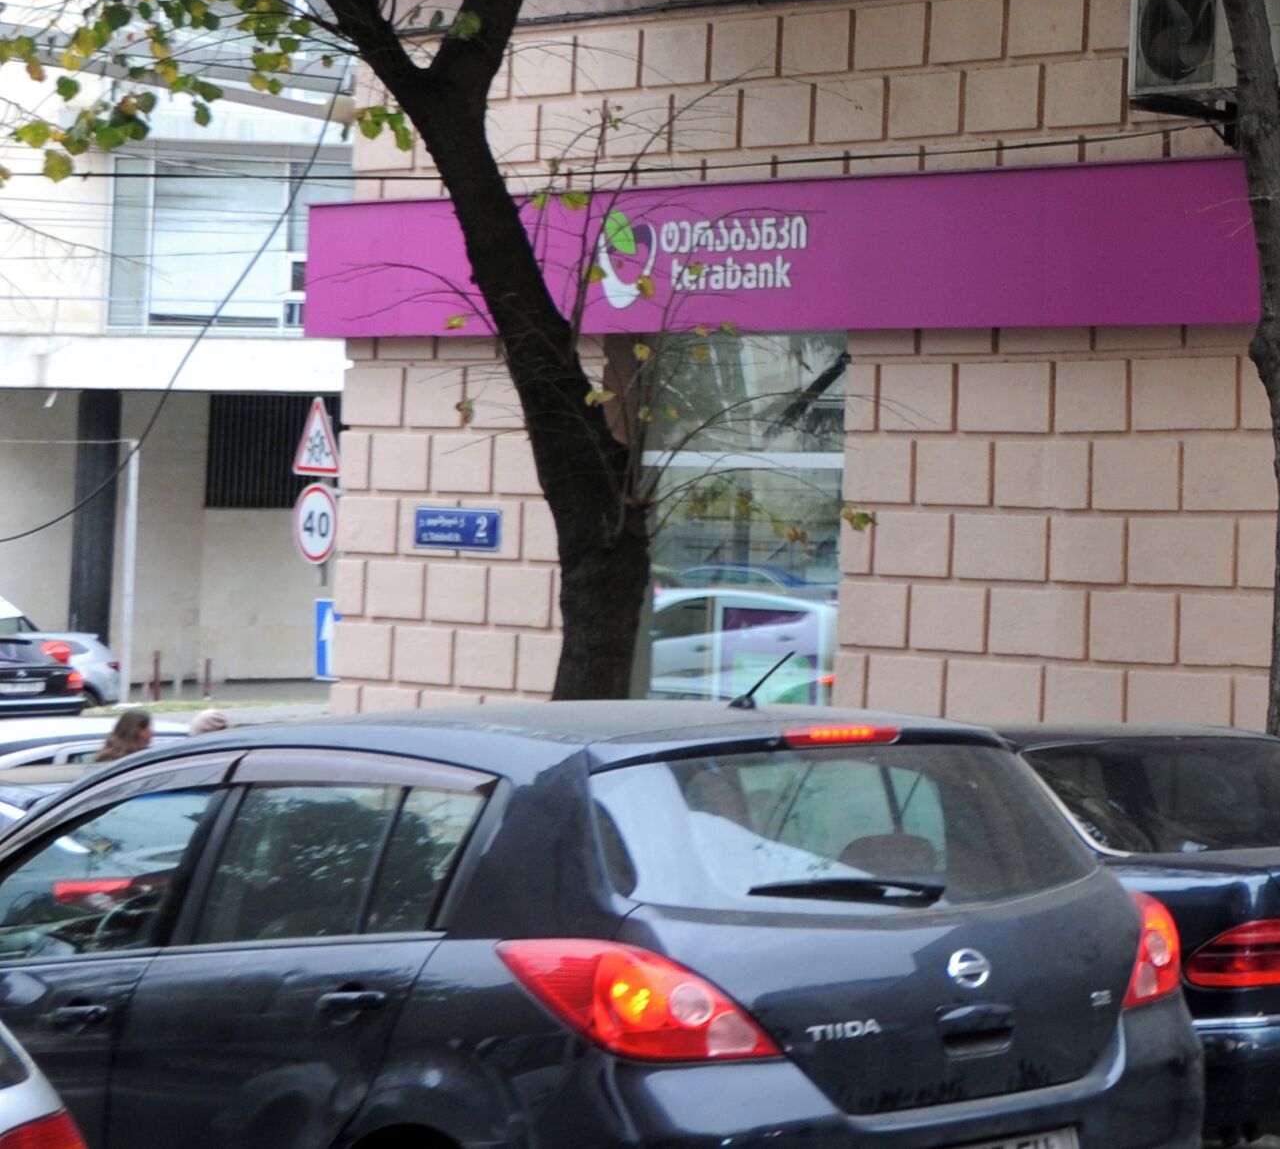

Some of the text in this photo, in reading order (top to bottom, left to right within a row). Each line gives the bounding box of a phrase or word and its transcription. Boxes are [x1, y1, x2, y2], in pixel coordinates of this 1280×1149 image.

[661, 214, 807, 253] ტერაბანკი
[671, 255, 792, 290] terabank
[303, 510, 330, 538] 40
[475, 515, 488, 538] 2
[805, 1018, 882, 1042] TIIDA
